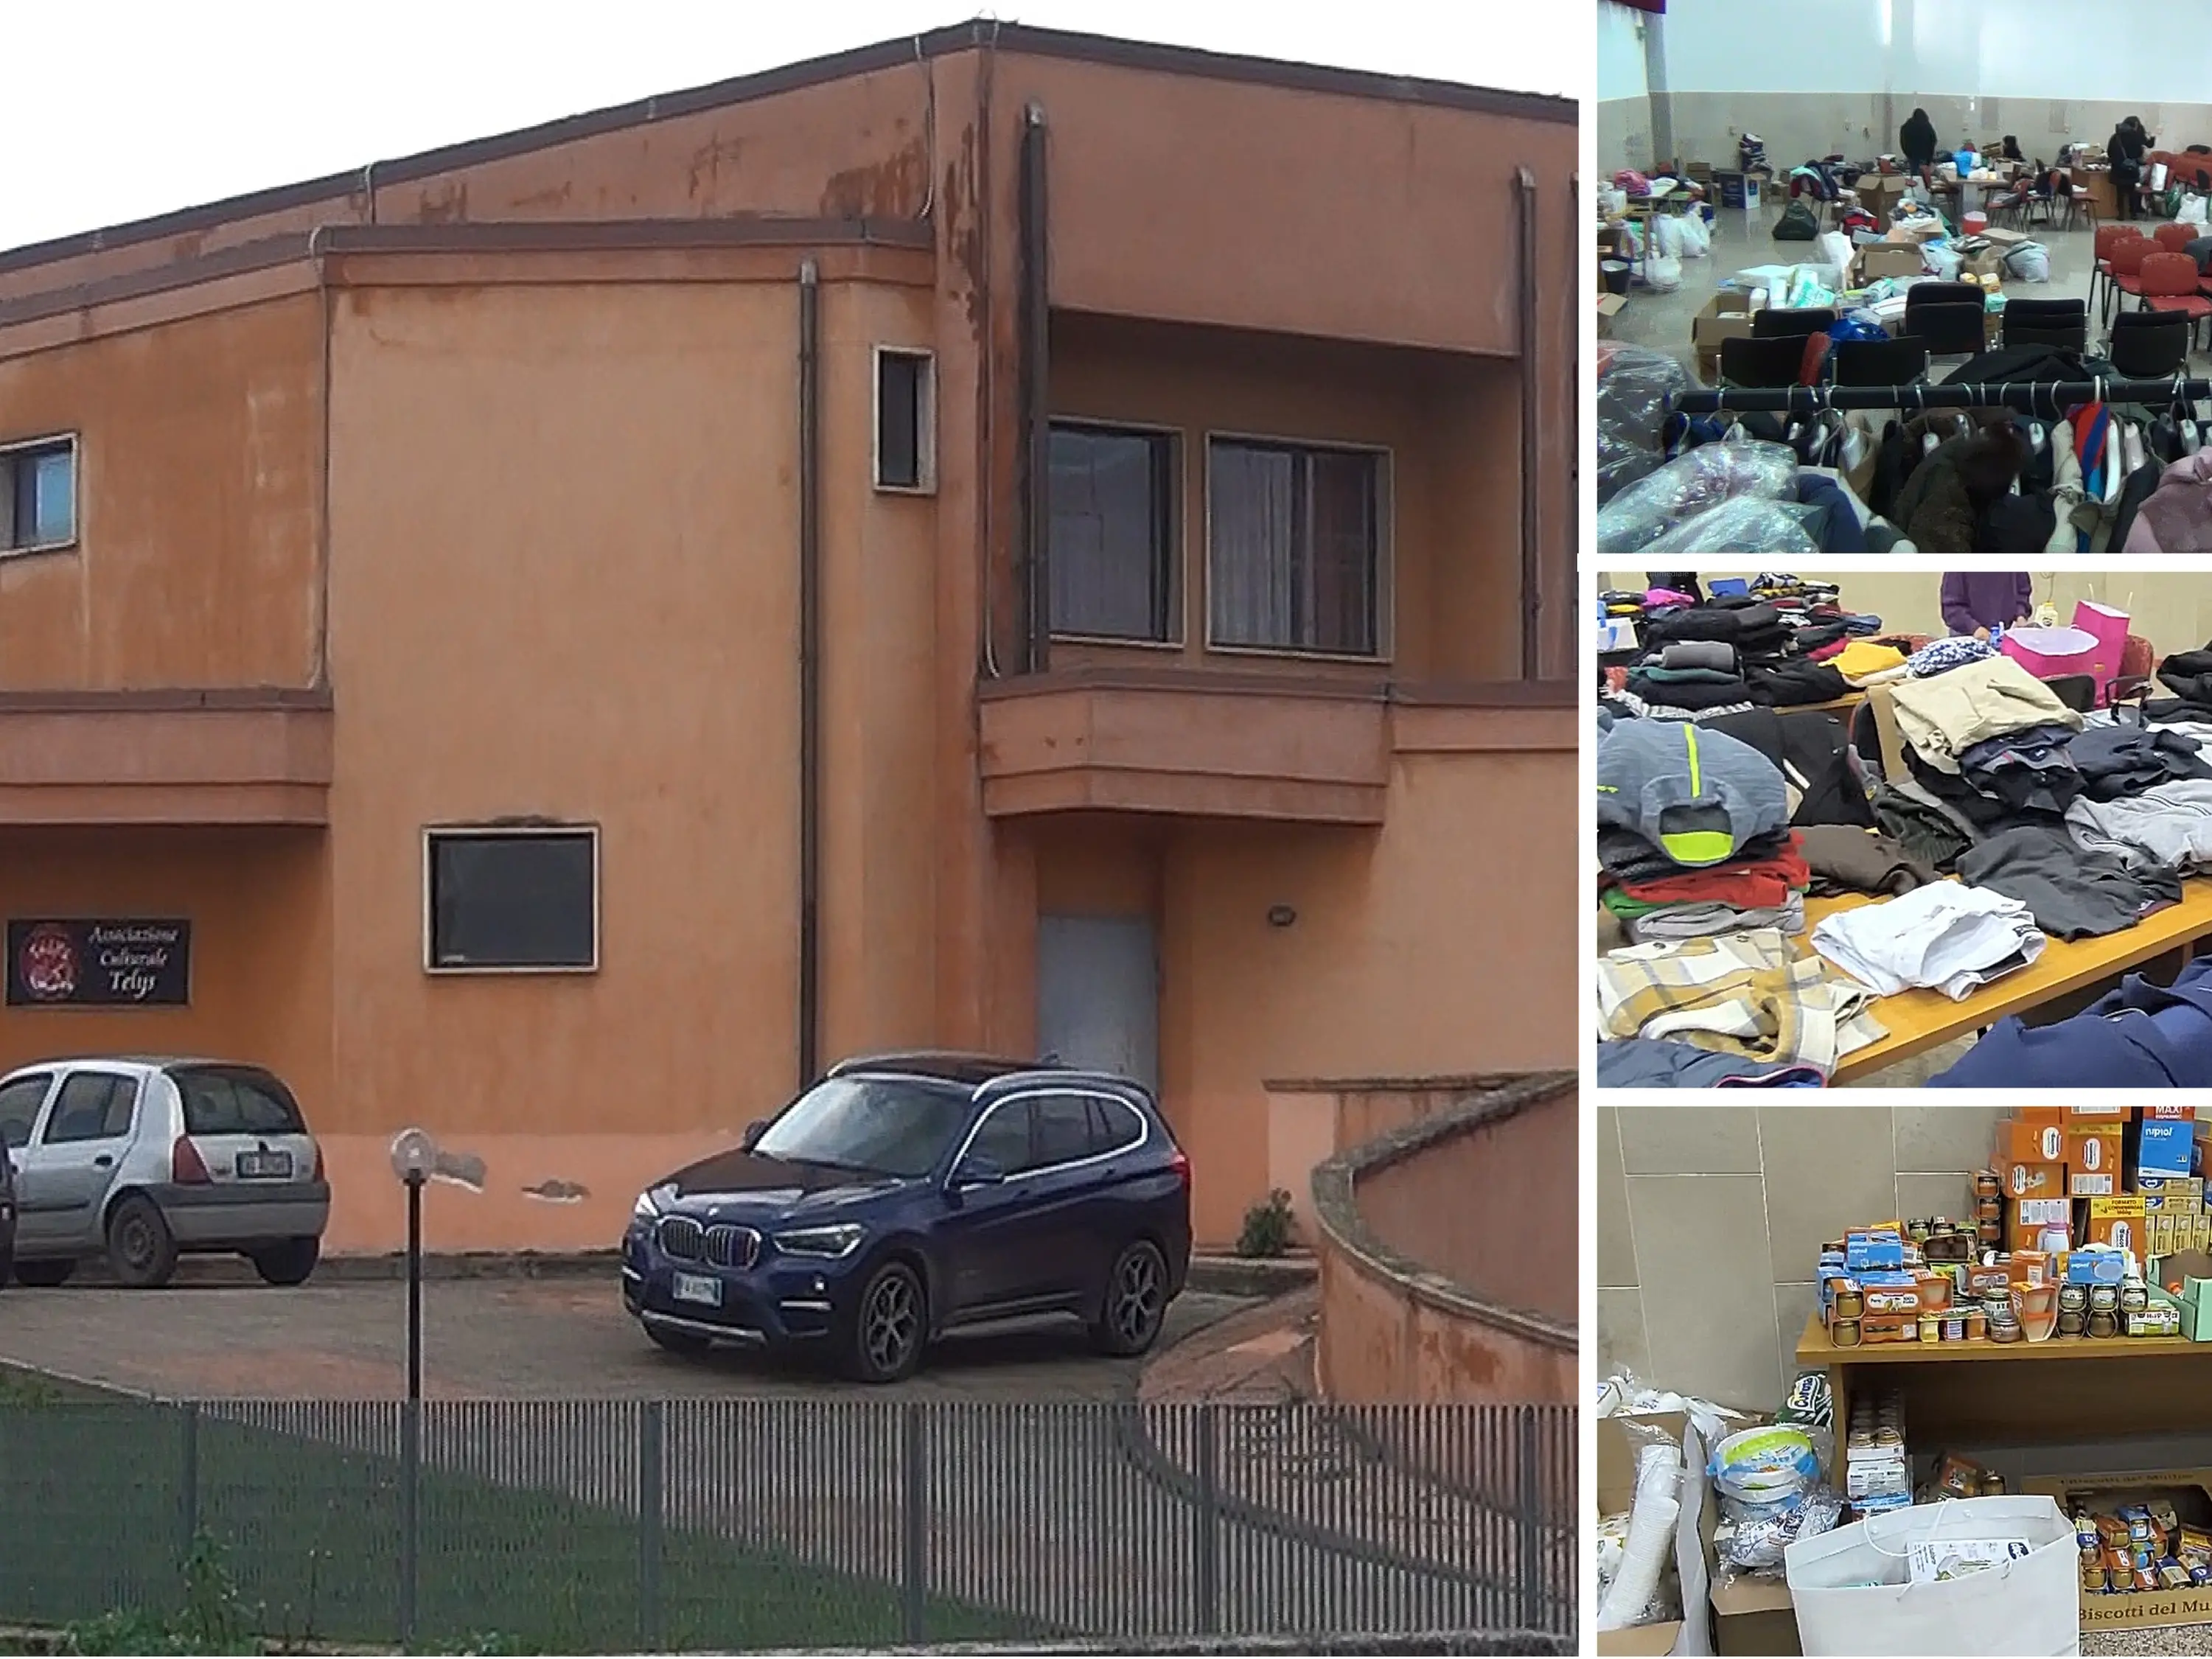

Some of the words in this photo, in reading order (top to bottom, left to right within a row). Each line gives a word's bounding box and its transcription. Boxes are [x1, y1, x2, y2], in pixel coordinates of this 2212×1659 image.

[2079, 1605, 2143, 1621] Biscotti
[2149, 1602, 2176, 1616] del
[2182, 1600, 2212, 1613] Mu
